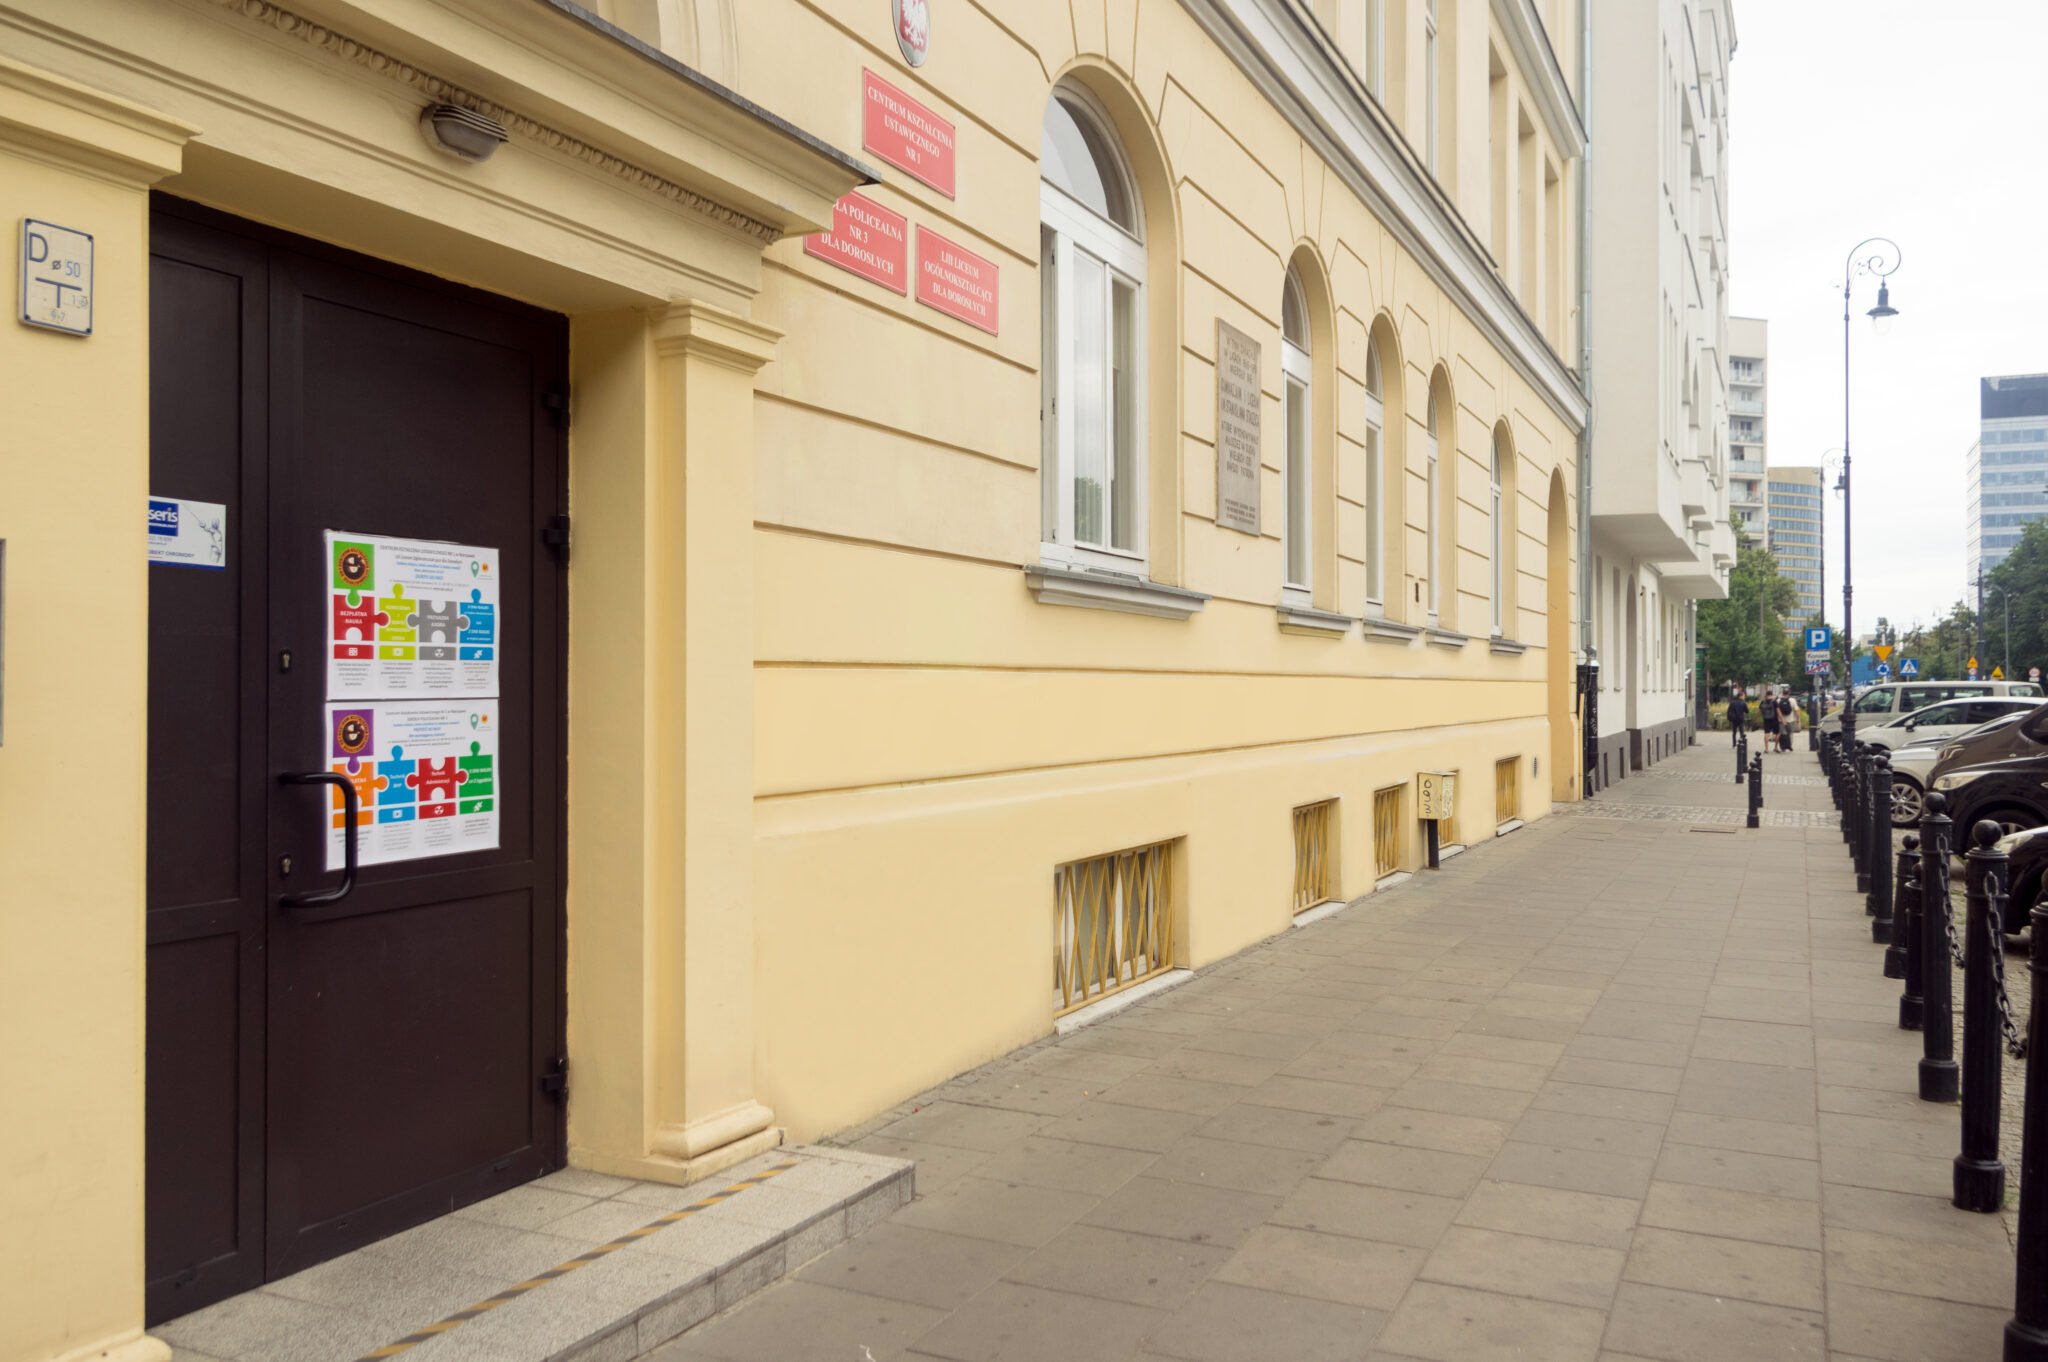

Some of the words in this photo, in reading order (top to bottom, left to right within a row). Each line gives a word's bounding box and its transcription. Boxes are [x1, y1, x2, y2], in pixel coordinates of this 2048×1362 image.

[868, 86, 905, 118] CENTRUM
[884, 115, 939, 157] USTAWICZNEGO
[906, 146, 916, 161] NR
[850, 205, 902, 242] POLICEALNA
[821, 232, 840, 250] DLA
[849, 225, 861, 240] NR
[864, 232, 868, 243] 3
[29, 232, 48, 262] D
[65, 261, 81, 278] 50
[941, 251, 953, 265] LIII
[955, 257, 979, 279] LICEUM
[933, 282, 946, 298] DLA
[1811, 630, 1825, 648] P
[1808, 664, 1829, 672] TAXI
